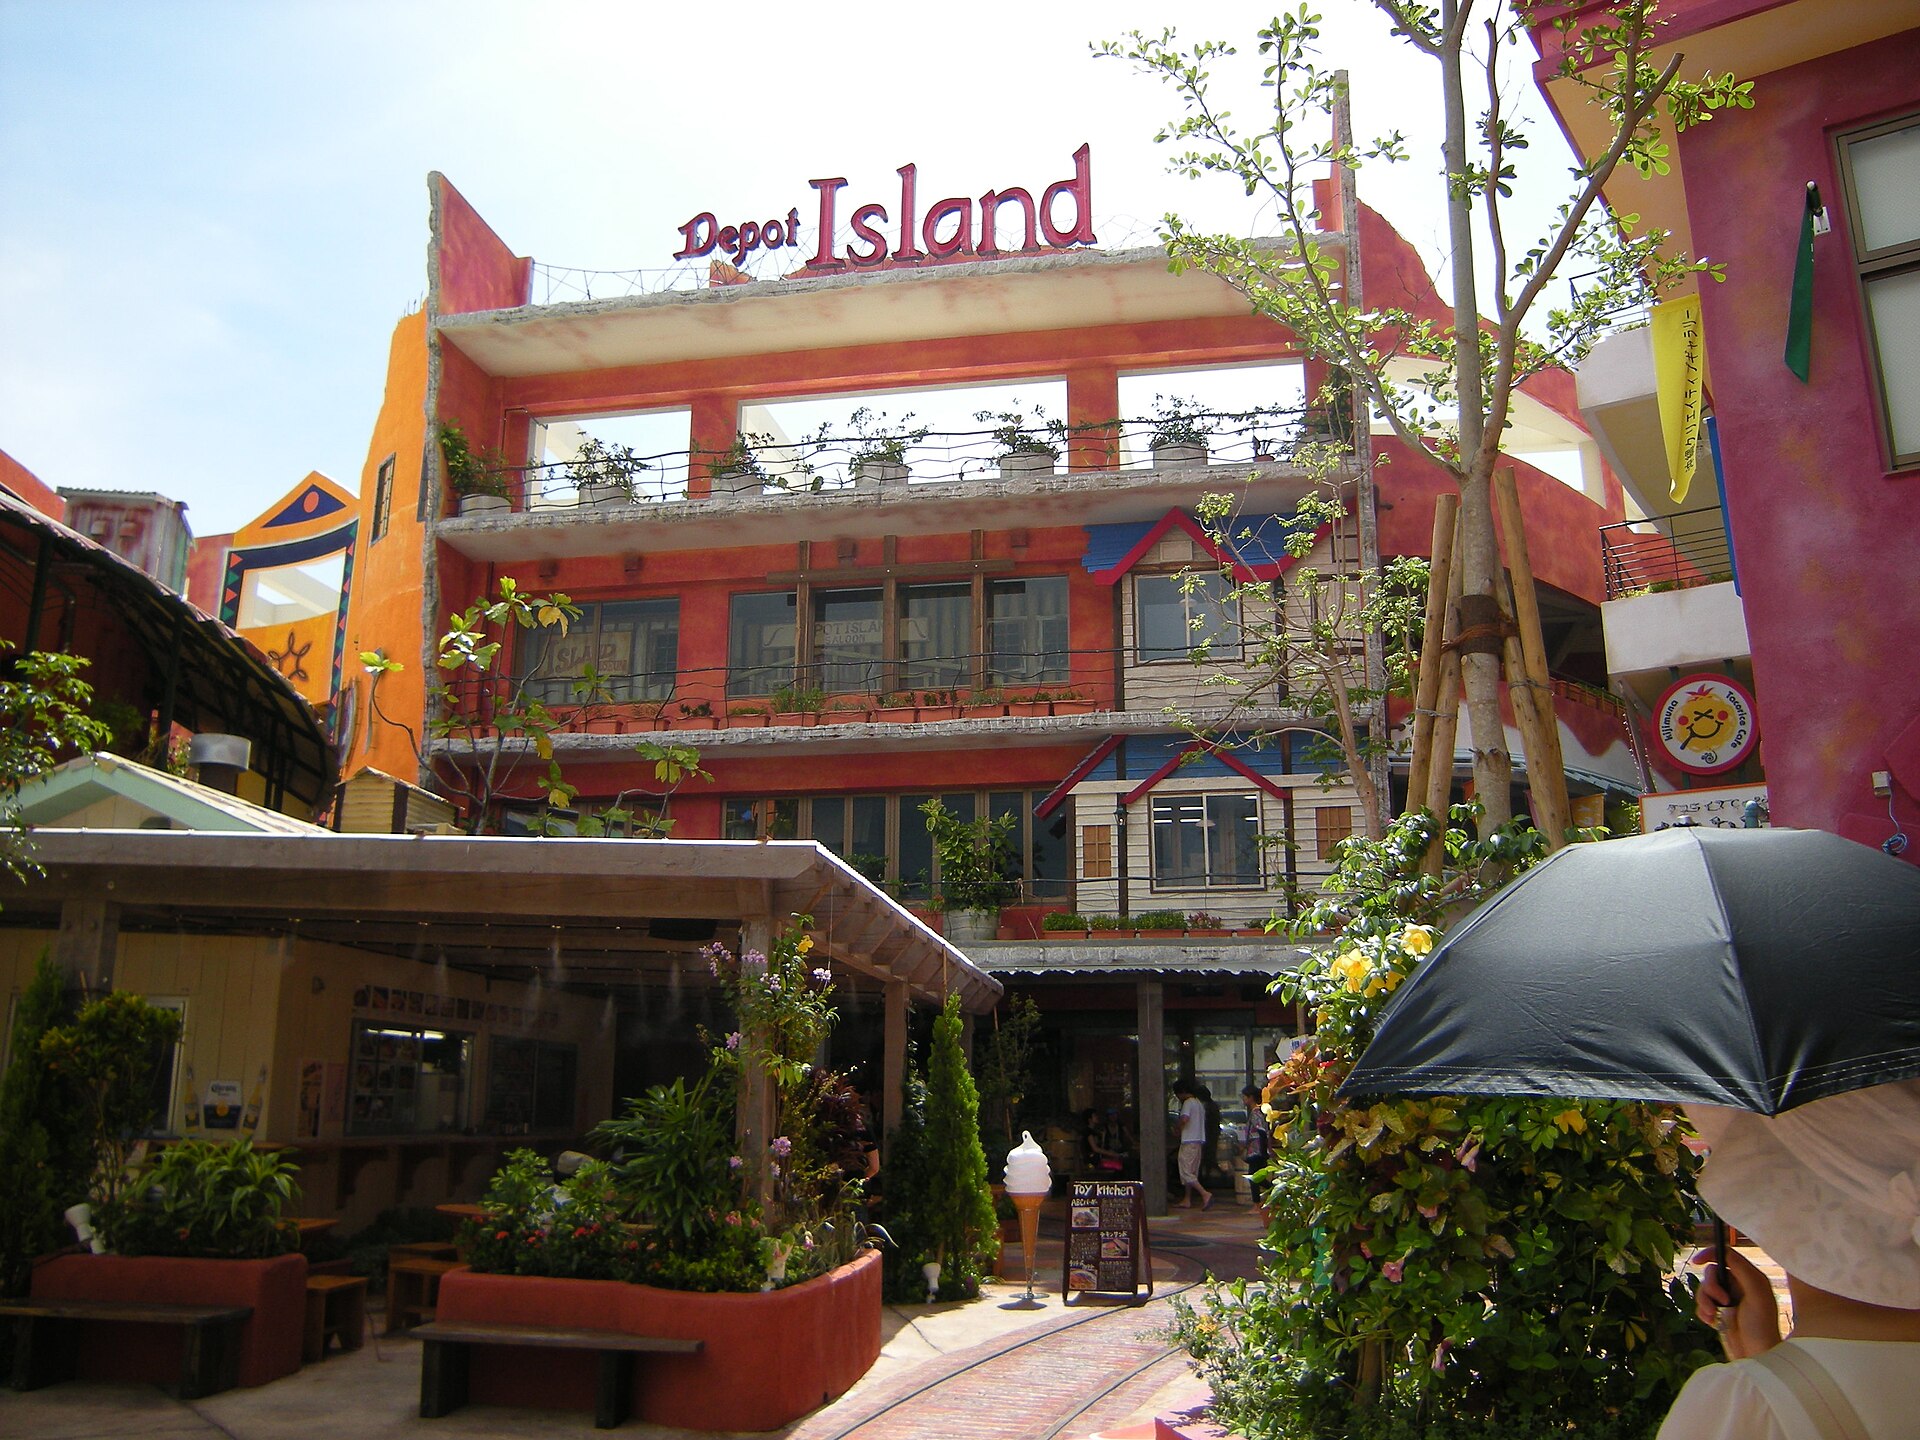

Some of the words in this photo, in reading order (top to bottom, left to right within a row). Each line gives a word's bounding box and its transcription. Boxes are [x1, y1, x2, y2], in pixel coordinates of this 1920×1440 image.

[673, 207, 801, 267] Depot
[805, 143, 1097, 269] Island
[815, 622, 843, 635] POT
[845, 620, 881, 634] ISLA
[1725, 691, 1748, 726] Tacorice
[1731, 730, 1747, 748] Cafe
